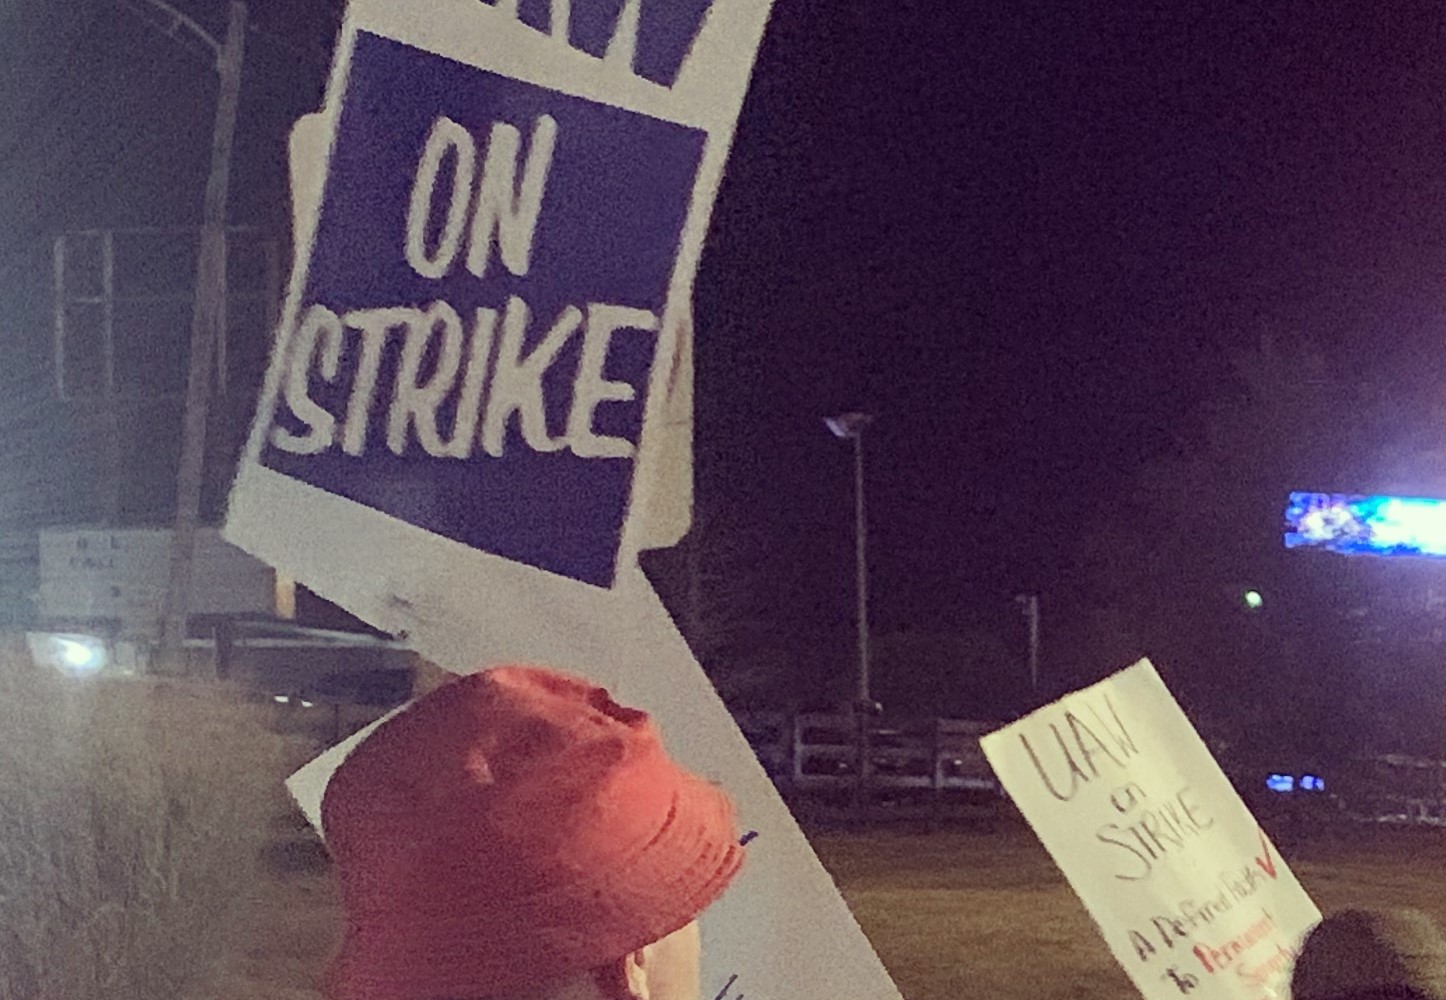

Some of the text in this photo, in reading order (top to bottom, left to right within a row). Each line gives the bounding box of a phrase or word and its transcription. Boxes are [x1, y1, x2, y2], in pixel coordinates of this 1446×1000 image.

[404, 114, 557, 279] ON
[270, 295, 659, 459] STRIKE
[1019, 694, 1139, 801] UAW
[1096, 786, 1214, 881] STRIKE
